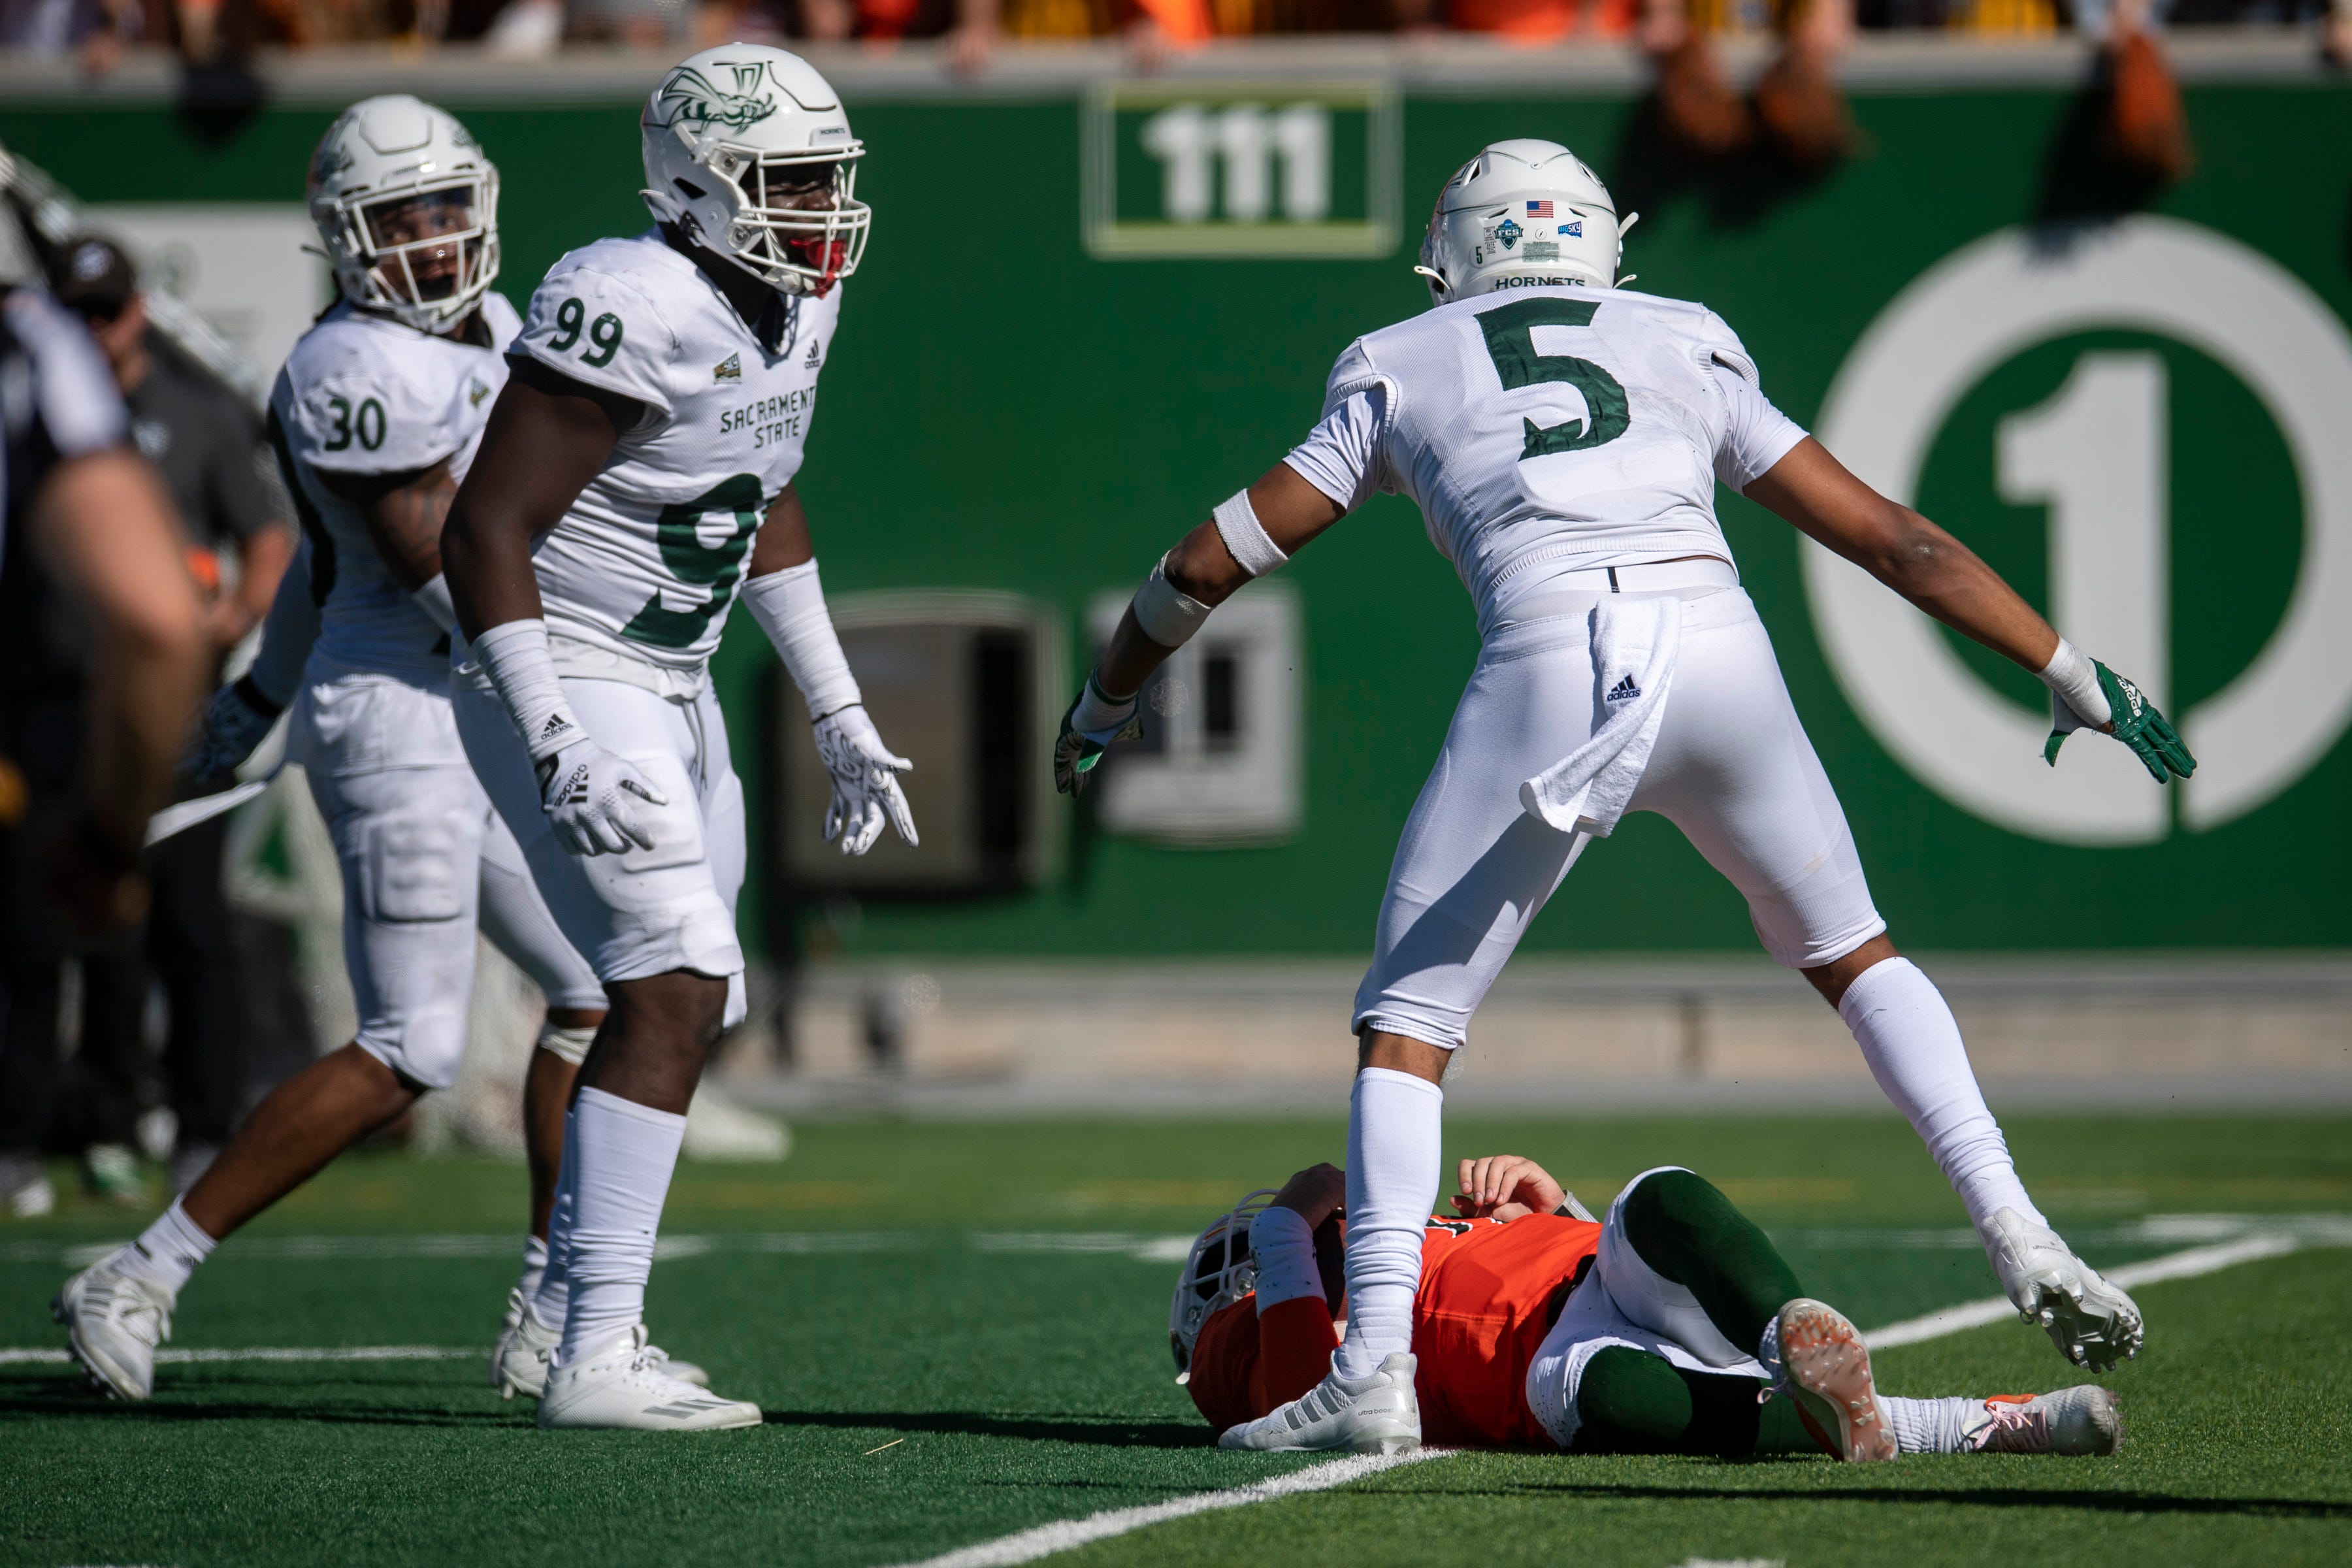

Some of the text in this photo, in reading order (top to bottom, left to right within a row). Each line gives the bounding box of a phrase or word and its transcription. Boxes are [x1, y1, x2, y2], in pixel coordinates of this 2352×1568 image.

[1142, 99, 1330, 222] 111
[1568, 222, 1581, 233] SKY
[1475, 246, 1483, 265] 5
[1495, 276, 1586, 289] HORNETS
[547, 297, 623, 368] 99
[1474, 297, 1631, 461] 5
[325, 397, 387, 451] 30
[754, 415, 800, 449] STATE
[1994, 350, 2170, 846] 1
[1607, 689, 1641, 701] adidas
[541, 723, 574, 740] adidas
